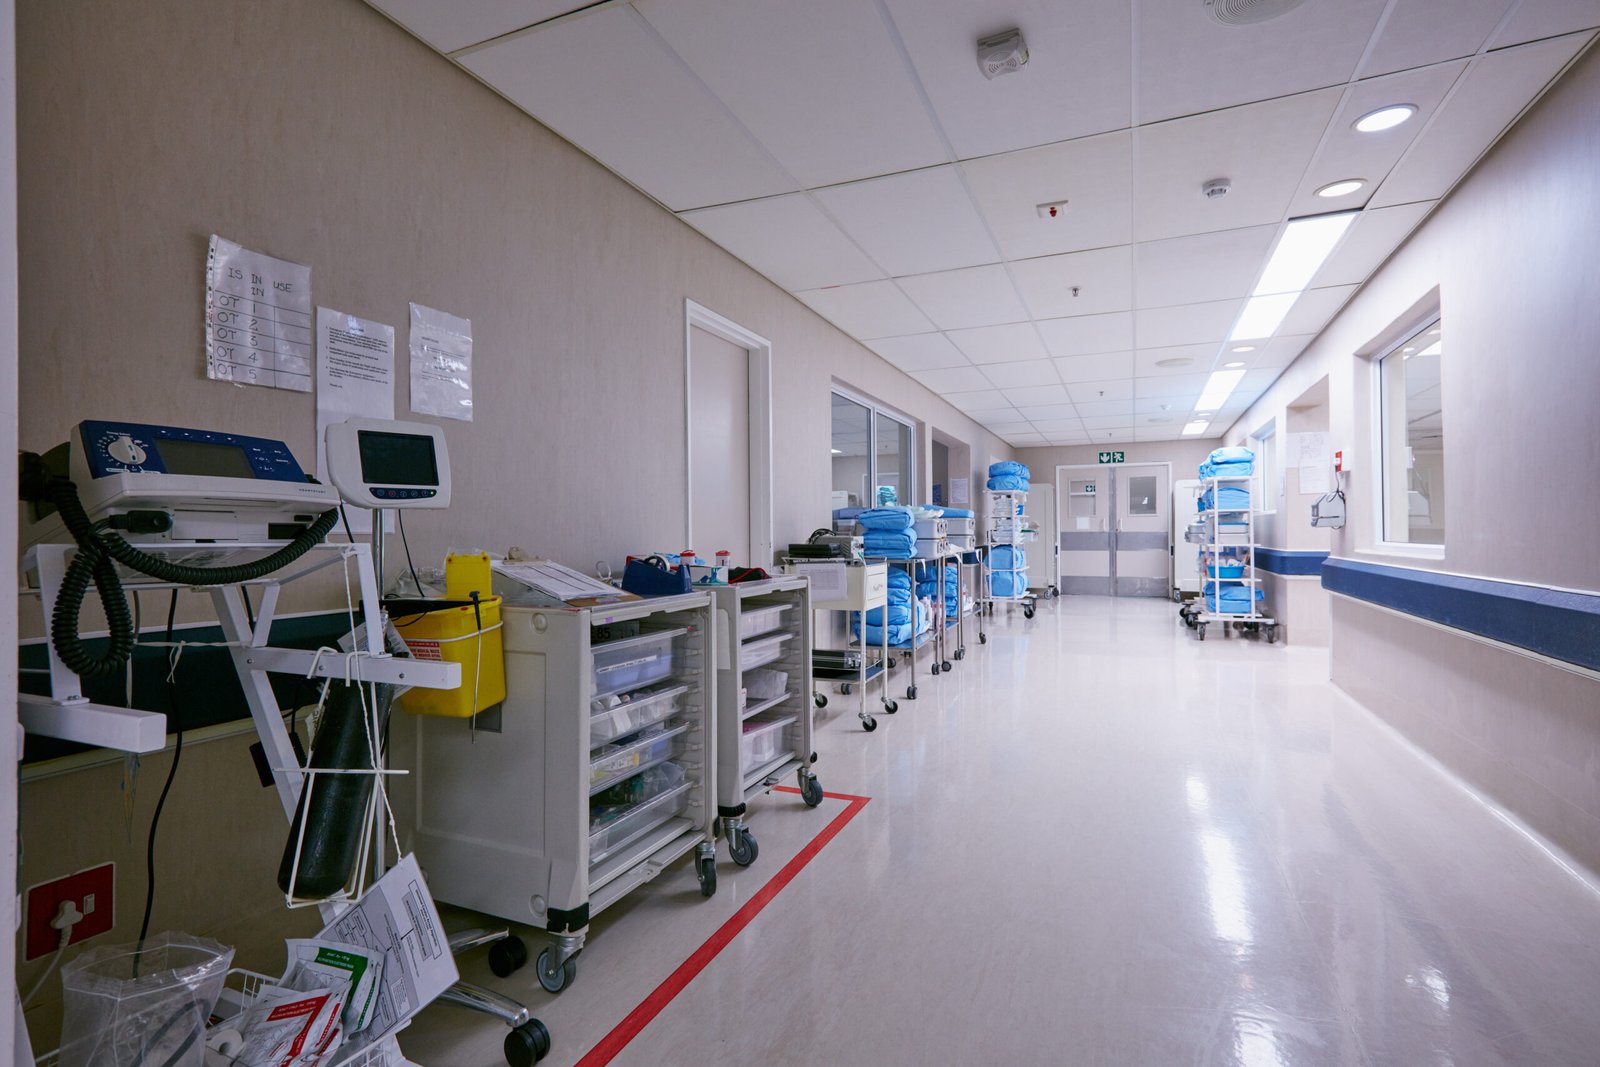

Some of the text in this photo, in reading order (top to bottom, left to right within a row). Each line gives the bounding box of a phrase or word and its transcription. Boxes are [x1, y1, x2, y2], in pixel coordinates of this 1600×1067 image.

[228, 267, 294, 293] IS IN USE
[251, 286, 264, 297] IN
[219, 295, 240, 308] OT
[217, 311, 258, 332] OT 2
[217, 327, 258, 347] OT 3
[216, 345, 257, 364] OT 4
[217, 363, 257, 380] OT 5
